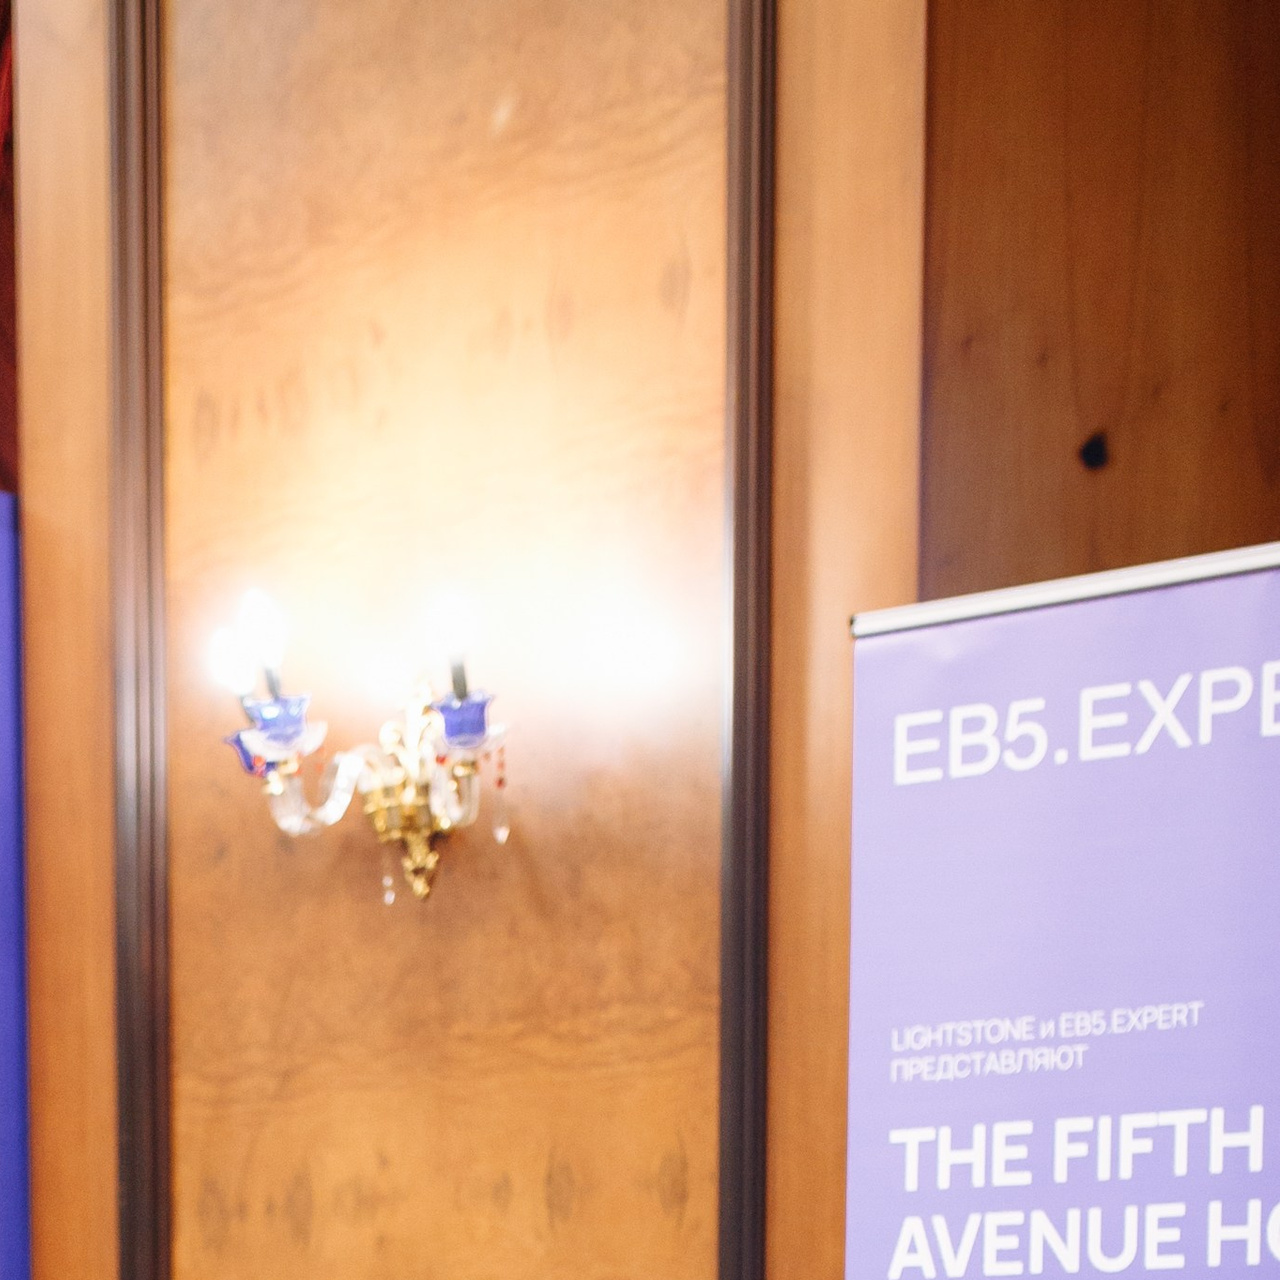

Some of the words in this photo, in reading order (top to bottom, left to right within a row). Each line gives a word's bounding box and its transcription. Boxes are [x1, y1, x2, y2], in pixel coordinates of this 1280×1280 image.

[891, 1015, 1036, 1053] LIGHTSTONE
[1039, 1018, 1056, 1039] и
[890, 1043, 1091, 1083] ПРЕДСТАВЛЯЮТ
[888, 1119, 1034, 1193] THE
[1053, 1104, 1265, 1185] FIFTH
[1206, 1198, 1280, 1268] H
